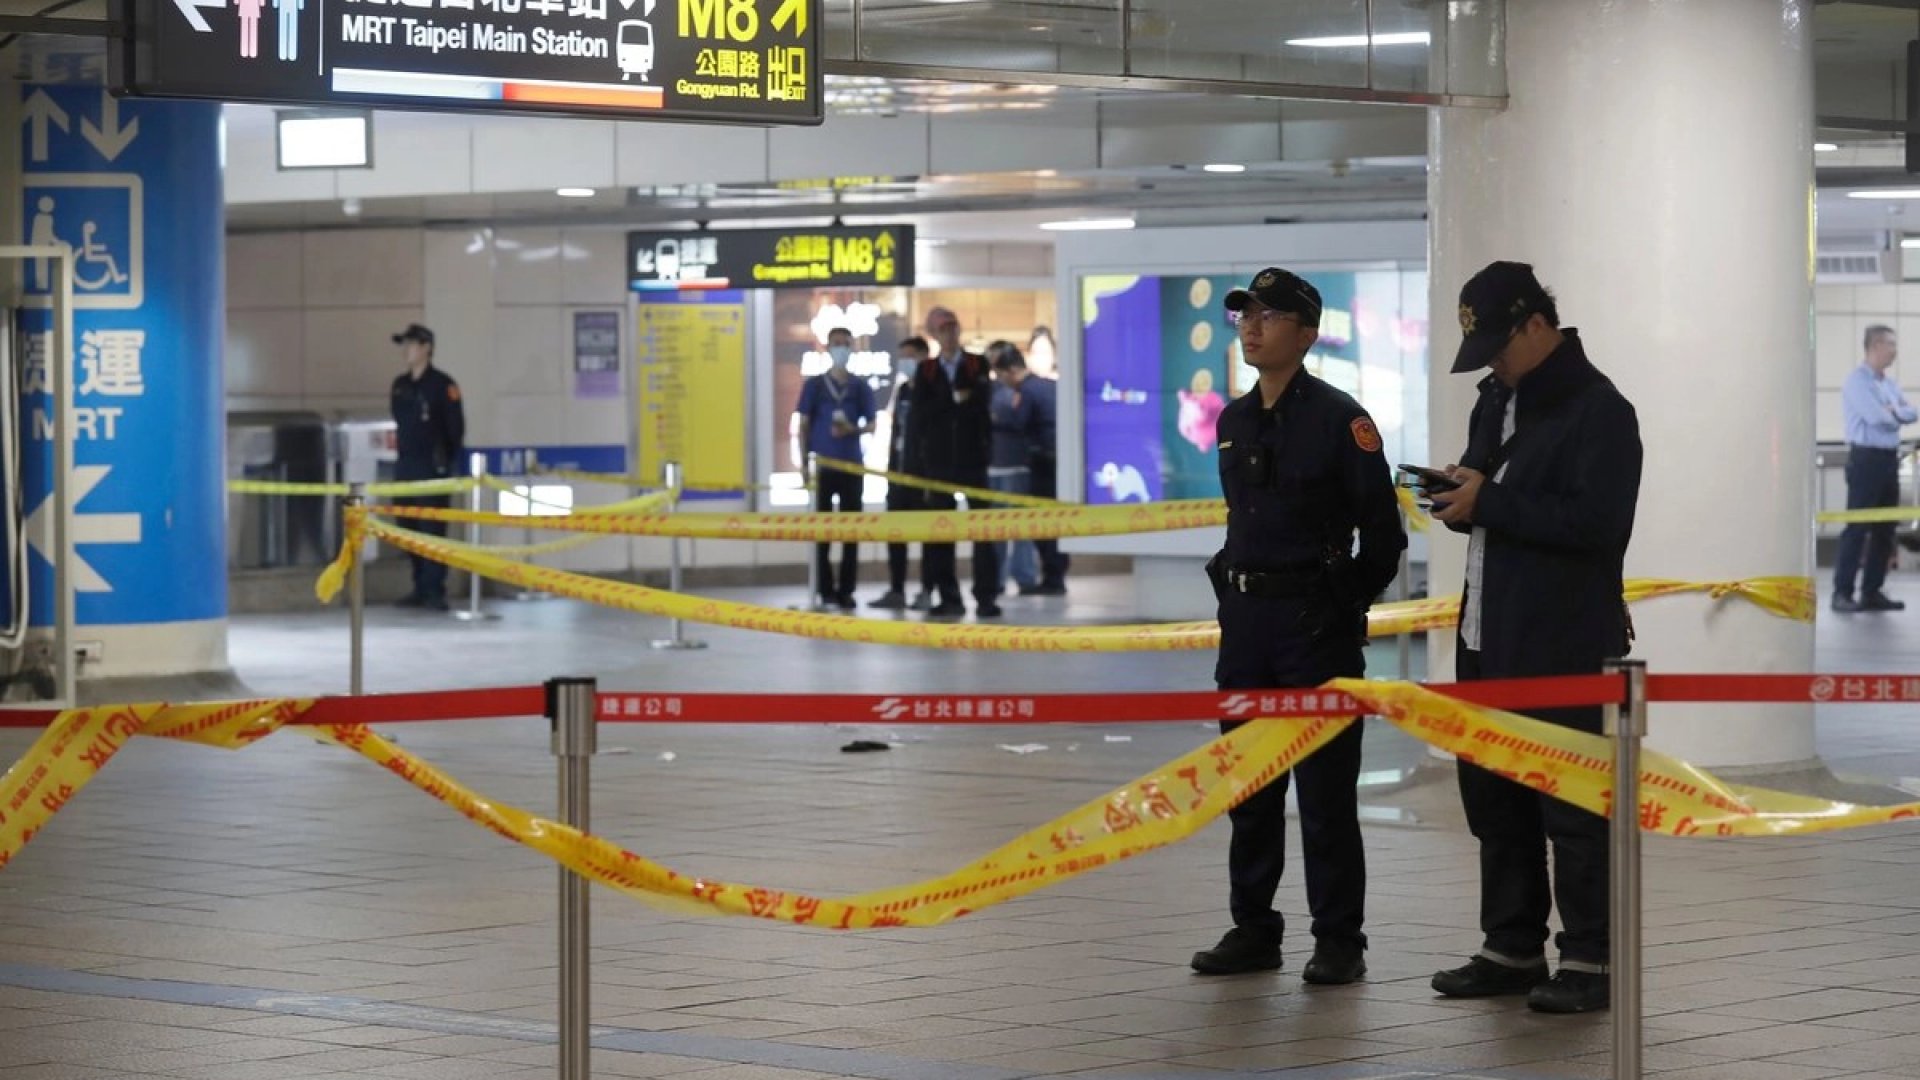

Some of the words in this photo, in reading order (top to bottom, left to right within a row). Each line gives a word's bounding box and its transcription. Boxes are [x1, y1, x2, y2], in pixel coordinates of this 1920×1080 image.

[341, 14, 397, 44] MRT
[401, 18, 467, 54] Taipei
[472, 23, 527, 53] Main
[532, 26, 609, 58] Station
[678, 0, 759, 42] M8
[695, 49, 760, 78] 公園路
[767, 45, 806, 101] 出口
[676, 79, 738, 99] Gongyuan
[741, 83, 760, 98] Rd.
[787, 87, 806, 100] EXIT
[832, 237, 874, 272] M8
[914, 699, 1035, 717] 台北捷運公司
